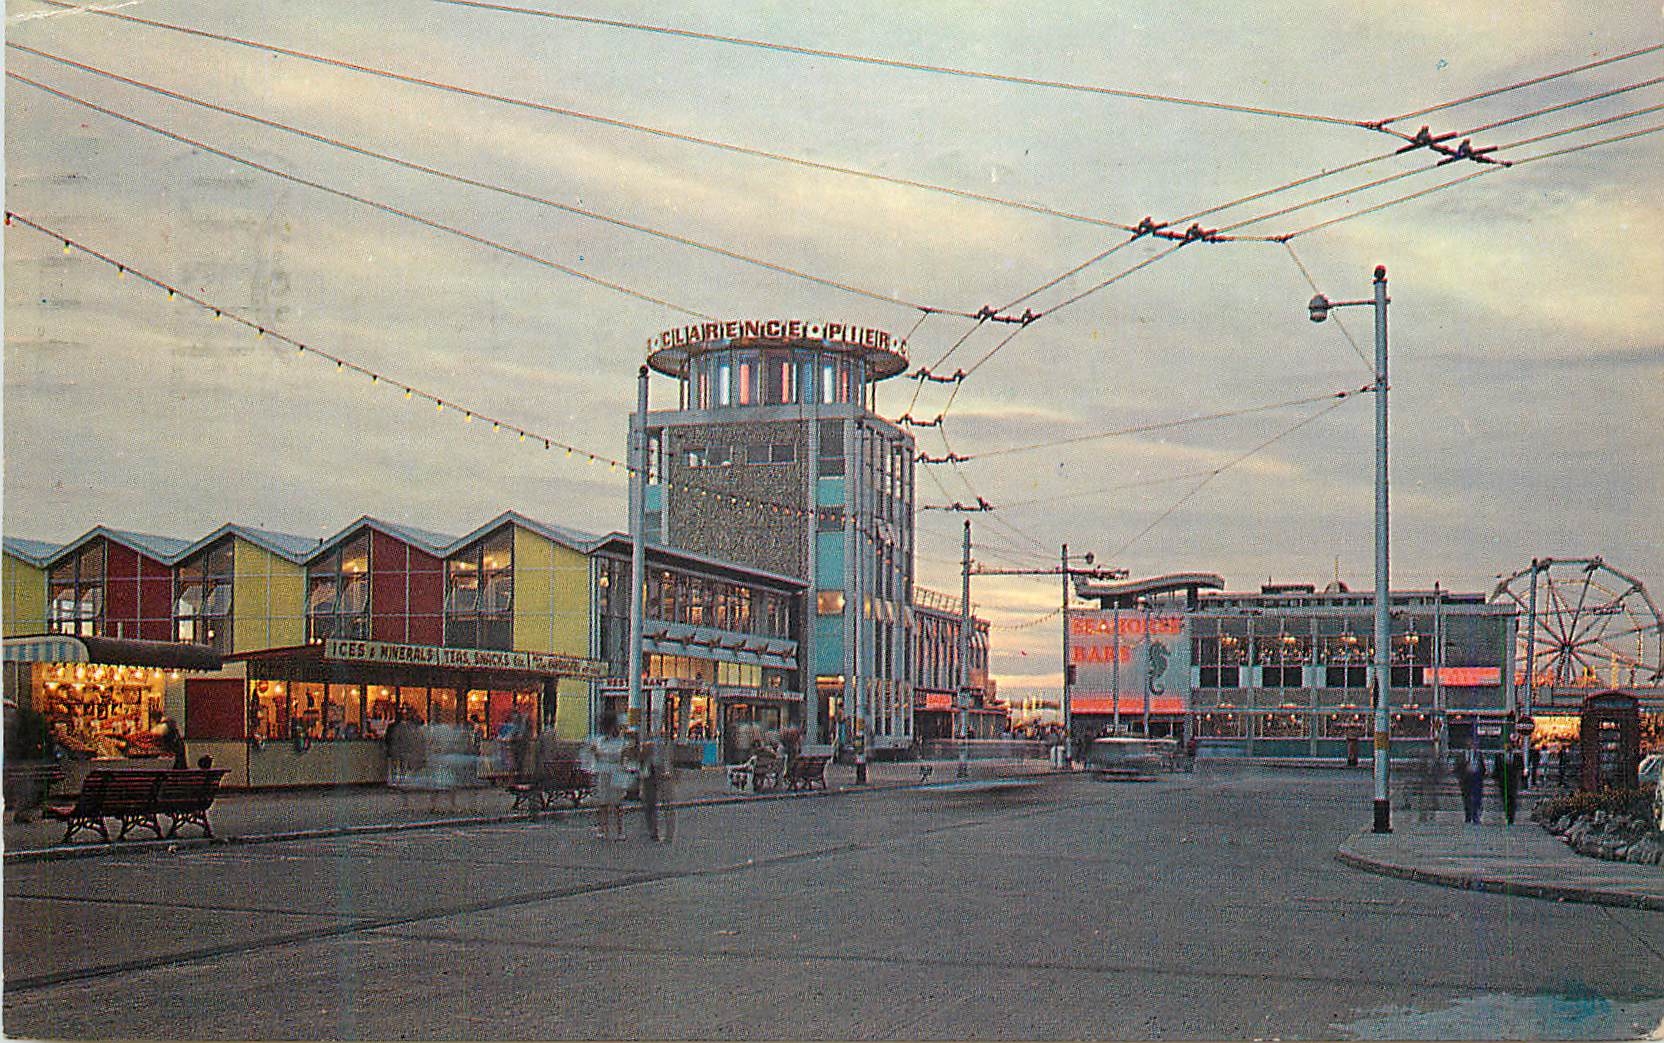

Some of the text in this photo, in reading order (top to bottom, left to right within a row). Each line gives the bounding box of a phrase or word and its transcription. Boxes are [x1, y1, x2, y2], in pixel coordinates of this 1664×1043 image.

[662, 320, 801, 346] CLARENCE
[829, 322, 890, 348] PIER
[332, 641, 366, 657] ICES
[380, 644, 433, 662] MINERALS
[1073, 645, 1131, 662] BARS
